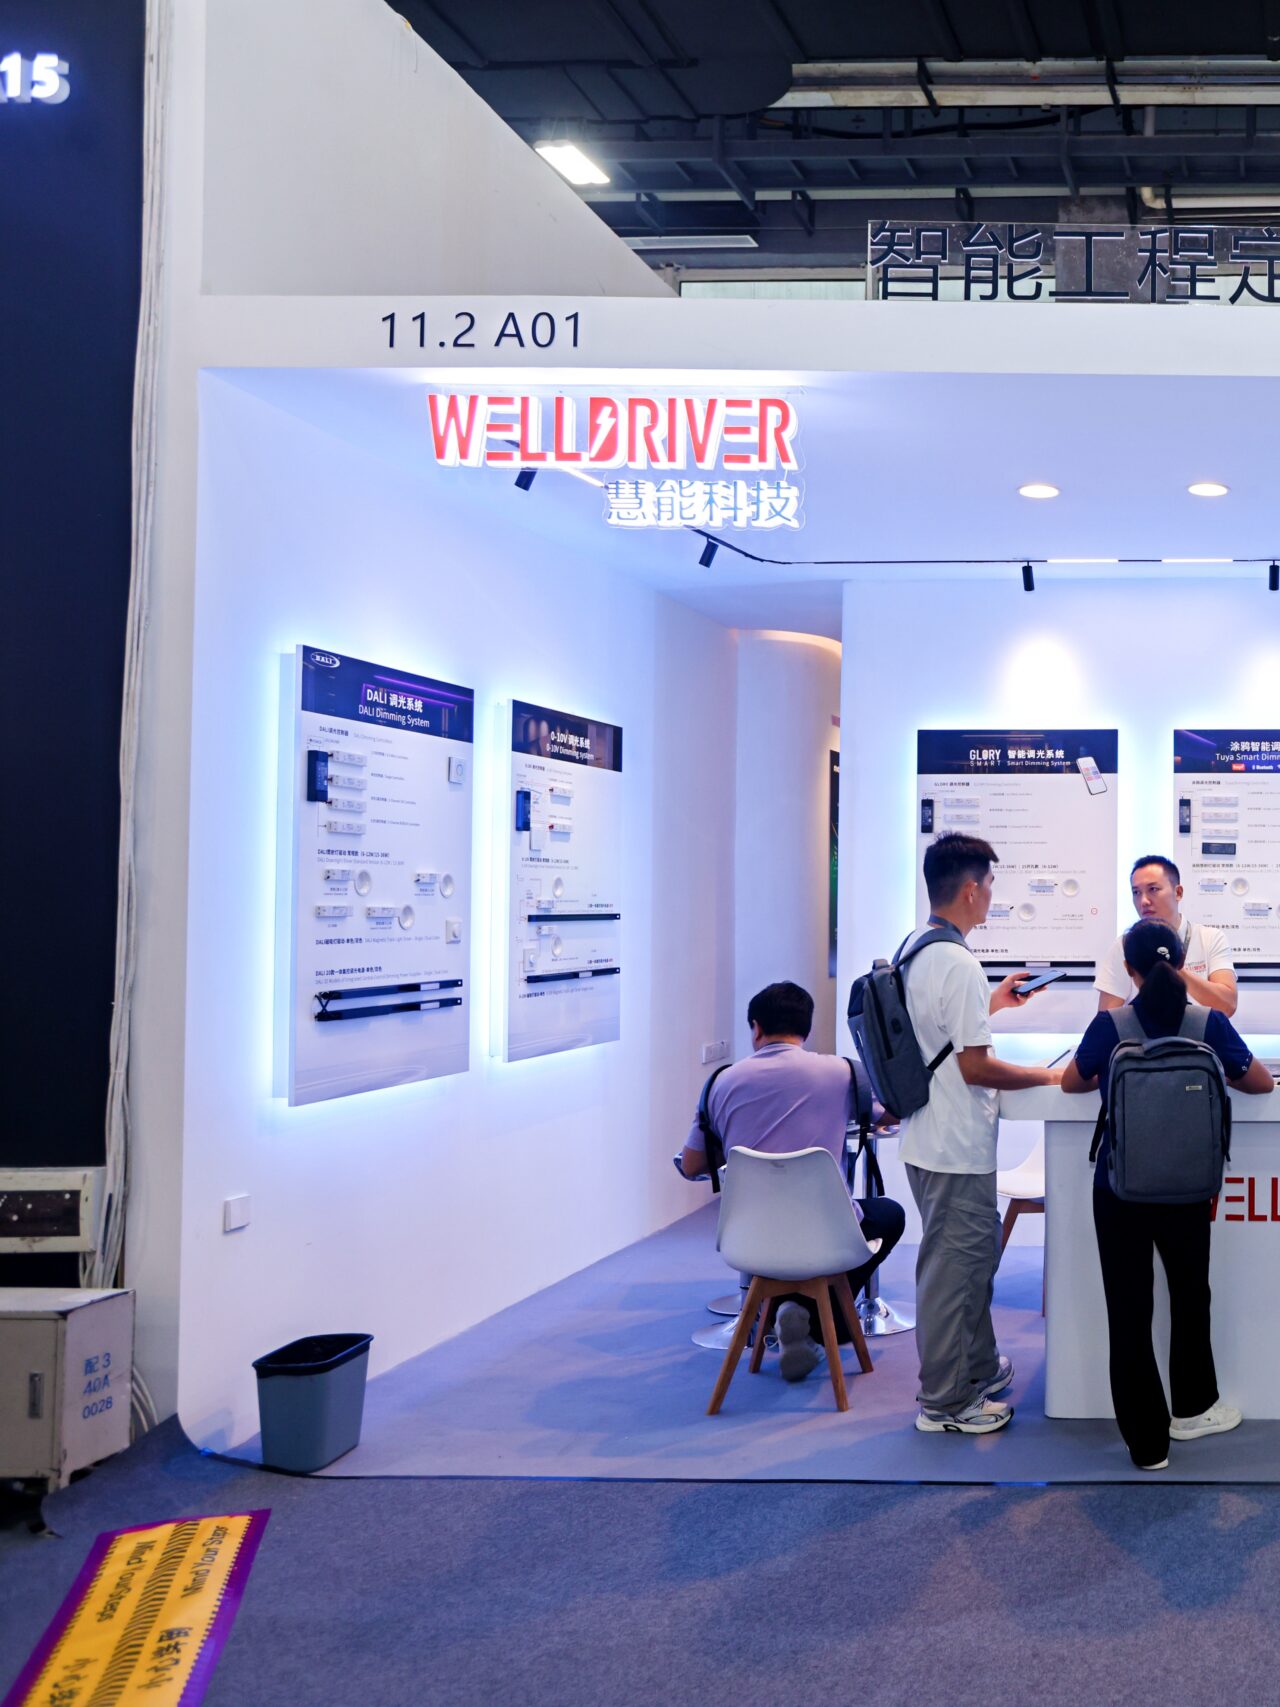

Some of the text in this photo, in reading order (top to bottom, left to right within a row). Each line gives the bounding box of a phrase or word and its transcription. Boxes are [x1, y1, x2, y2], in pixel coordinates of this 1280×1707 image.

[0, 51, 70, 104] 15
[381, 312, 580, 348] 11.2 A01
[428, 394, 795, 467] WELLDRIVER
[608, 480, 798, 526] 慧能科技
[367, 689, 424, 713] DALI 调光系统
[359, 704, 430, 728] DALI Dimming System
[551, 731, 567, 743] 0-10V
[969, 749, 1001, 760] GLORY
[1007, 749, 1064, 759] 智能调光系统
[1216, 754, 1234, 762] Tuya
[1236, 753, 1260, 761] Smart
[127, 1540, 157, 1566] Mind
[181, 1525, 231, 1598] Mind Your Steps
